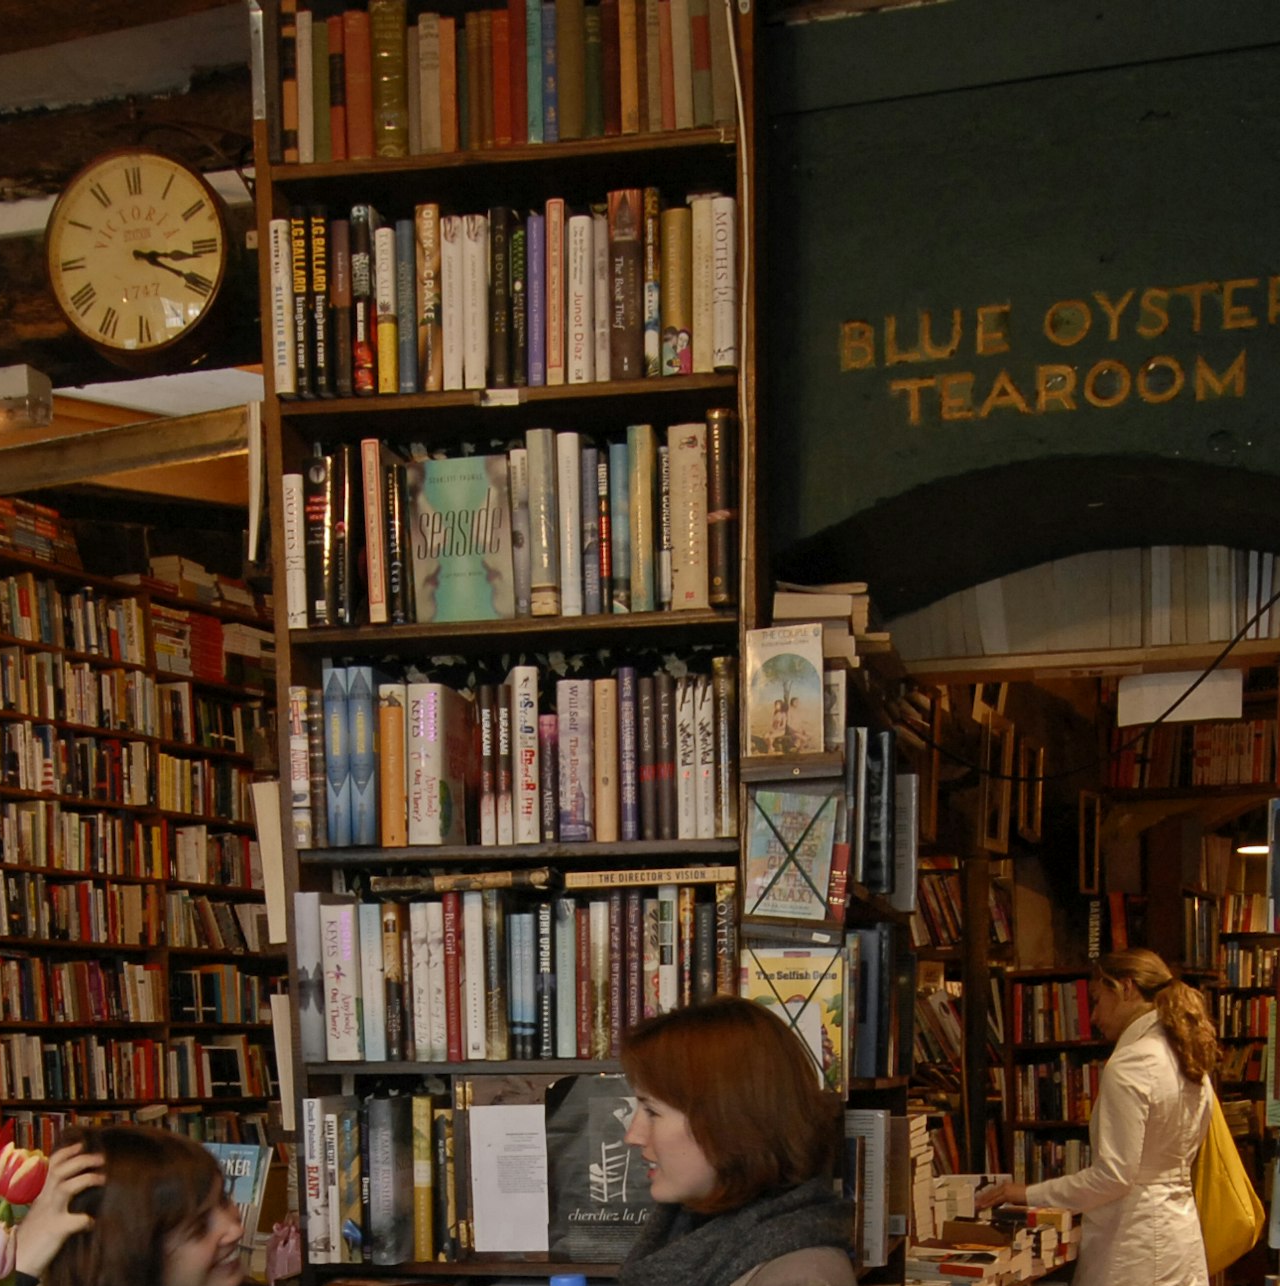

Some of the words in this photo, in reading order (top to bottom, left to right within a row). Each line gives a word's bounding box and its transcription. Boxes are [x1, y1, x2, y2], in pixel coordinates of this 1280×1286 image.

[716, 211, 728, 281] MOTHS
[423, 269, 435, 320] CRAKE
[574, 290, 583, 330] Junot
[840, 303, 1011, 372] BLUE
[888, 349, 1247, 425] TEAROOM
[418, 487, 503, 561] seaside
[599, 874, 616, 884] THE
[619, 871, 672, 884] DIRECTOR'S
[675, 870, 706, 882] VISION
[539, 904, 550, 934] JOHN
[539, 936, 550, 973] UPDIKE
[756, 968, 774, 981] The
[776, 968, 810, 981] Selfish
[308, 1164, 320, 1200] RANT
[568, 1208, 621, 1222] cherchez
[622, 1208, 635, 1222] la
